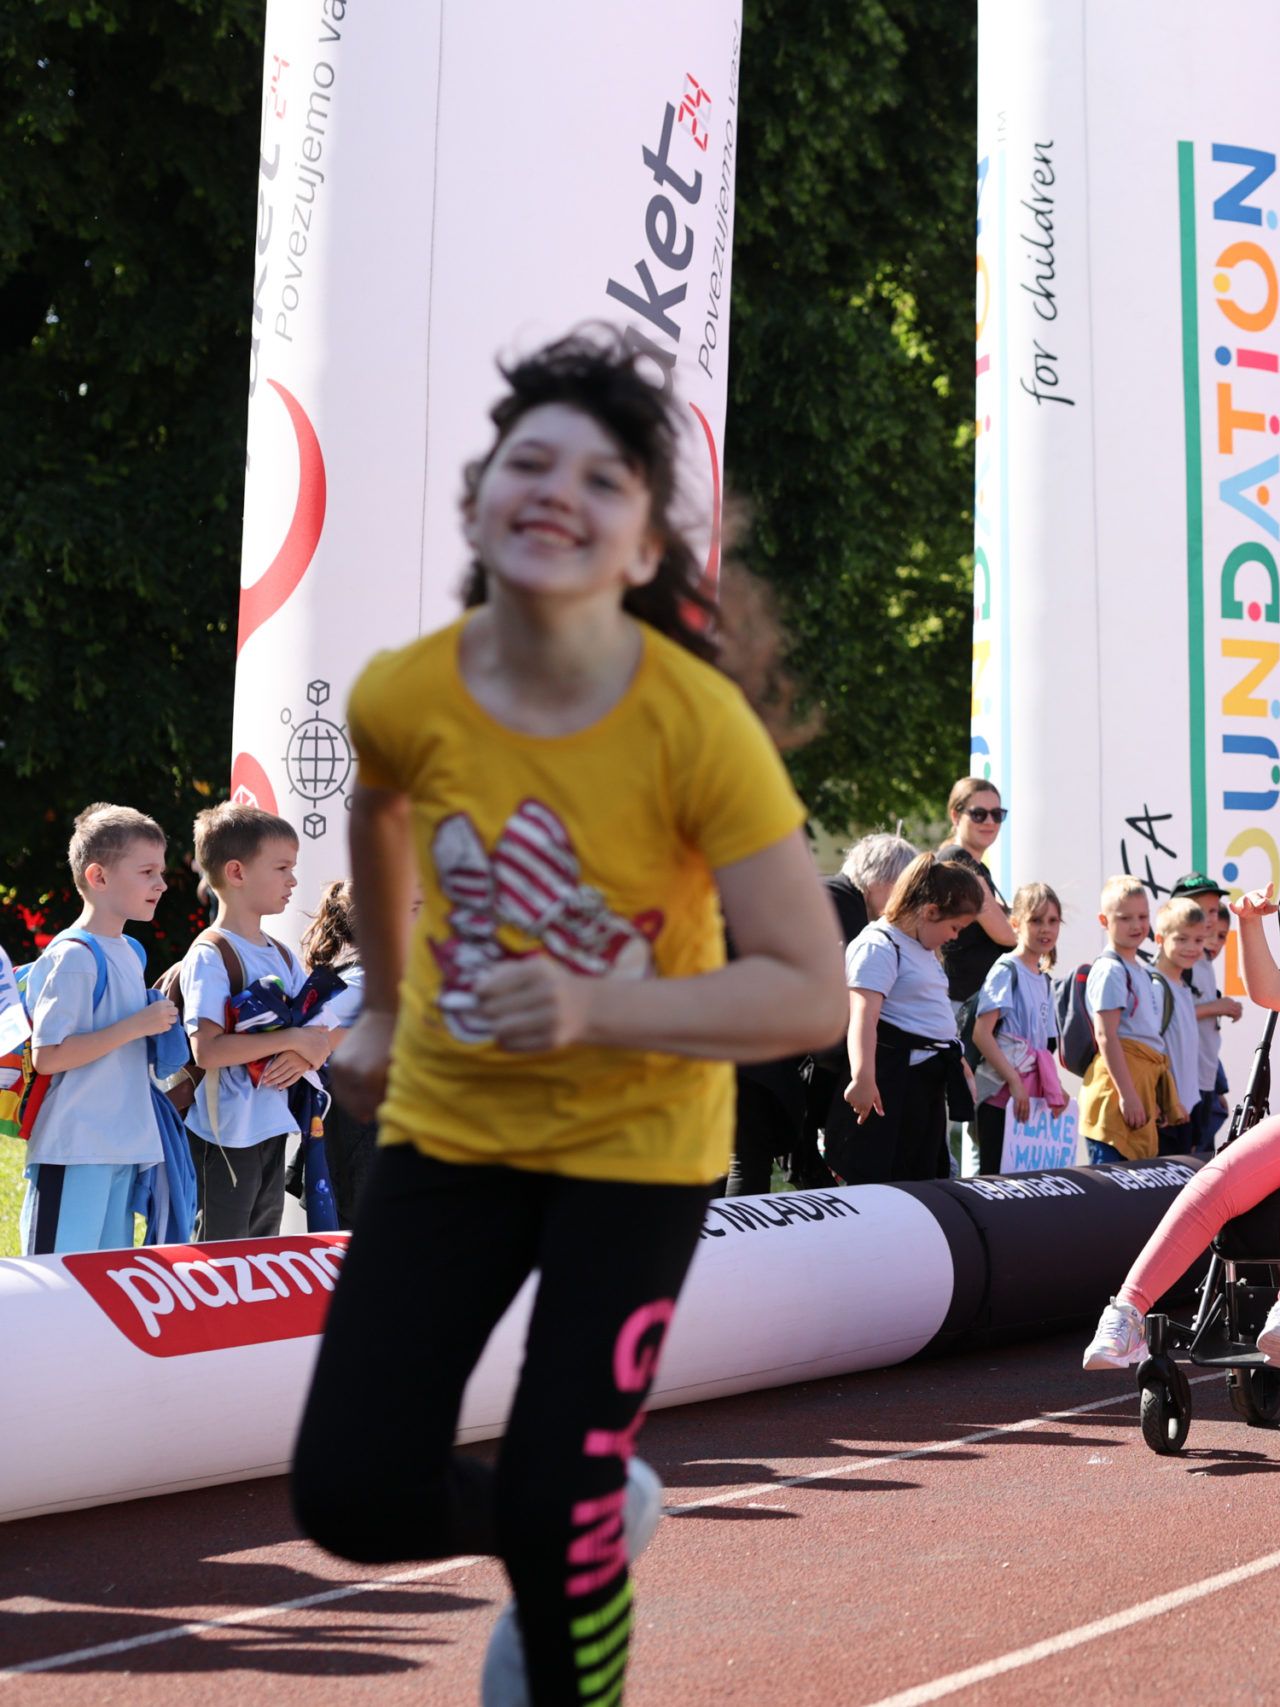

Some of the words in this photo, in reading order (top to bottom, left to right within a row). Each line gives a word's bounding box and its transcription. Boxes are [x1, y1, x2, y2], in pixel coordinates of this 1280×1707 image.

[275, 61, 336, 343] Povezujemo
[697, 118, 736, 380] Povezujemo
[1020, 140, 1058, 322] children
[1020, 340, 1076, 407] for
[708, 1192, 861, 1232] MLADIH
[954, 1173, 1086, 1201] telemach
